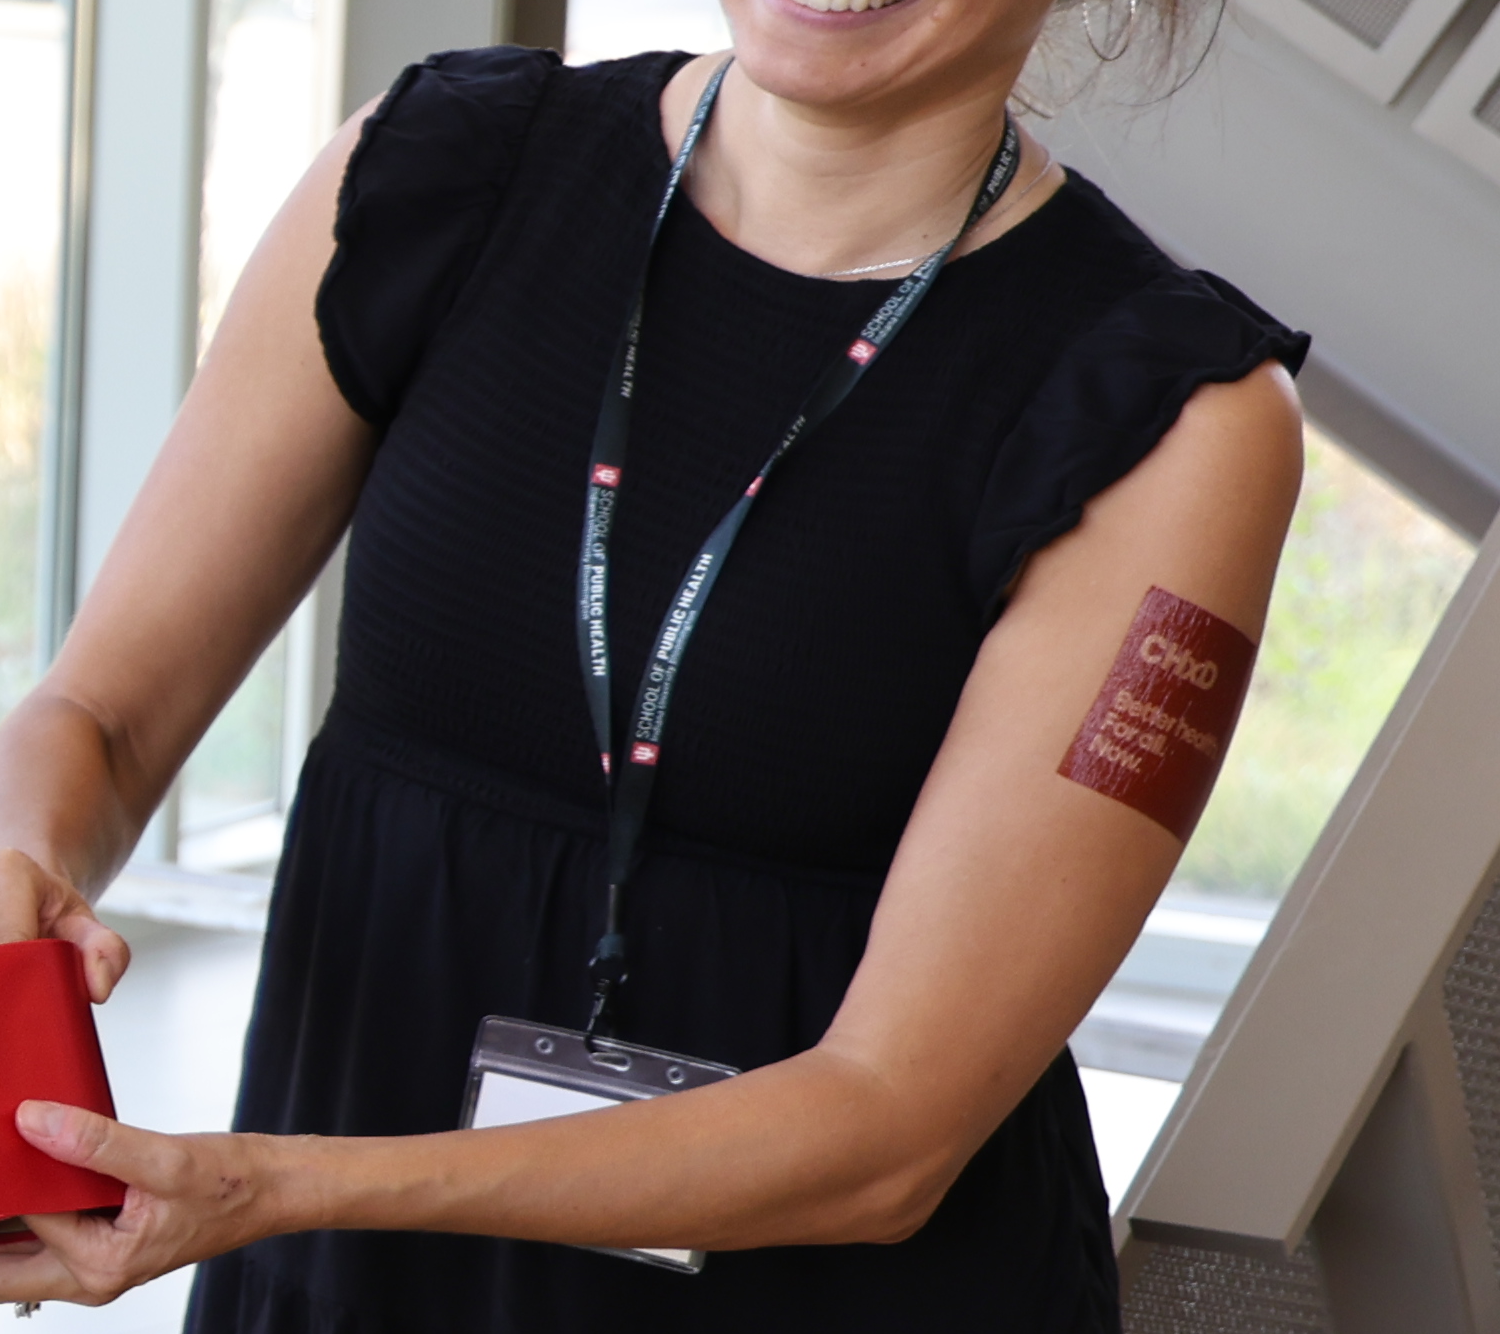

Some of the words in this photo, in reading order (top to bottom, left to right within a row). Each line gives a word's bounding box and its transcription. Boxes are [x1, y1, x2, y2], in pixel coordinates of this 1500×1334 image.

[860, 295, 905, 339] SCHOOL
[594, 488, 616, 538] SCHOOL
[592, 542, 606, 561] OF
[590, 564, 606, 616] PUBLIC
[677, 553, 714, 609] HEALTH
[589, 619, 607, 677] HEALTH
[655, 608, 688, 661] PUBLIC
[649, 663, 667, 682] OF
[635, 685, 662, 740] SCHOOL
